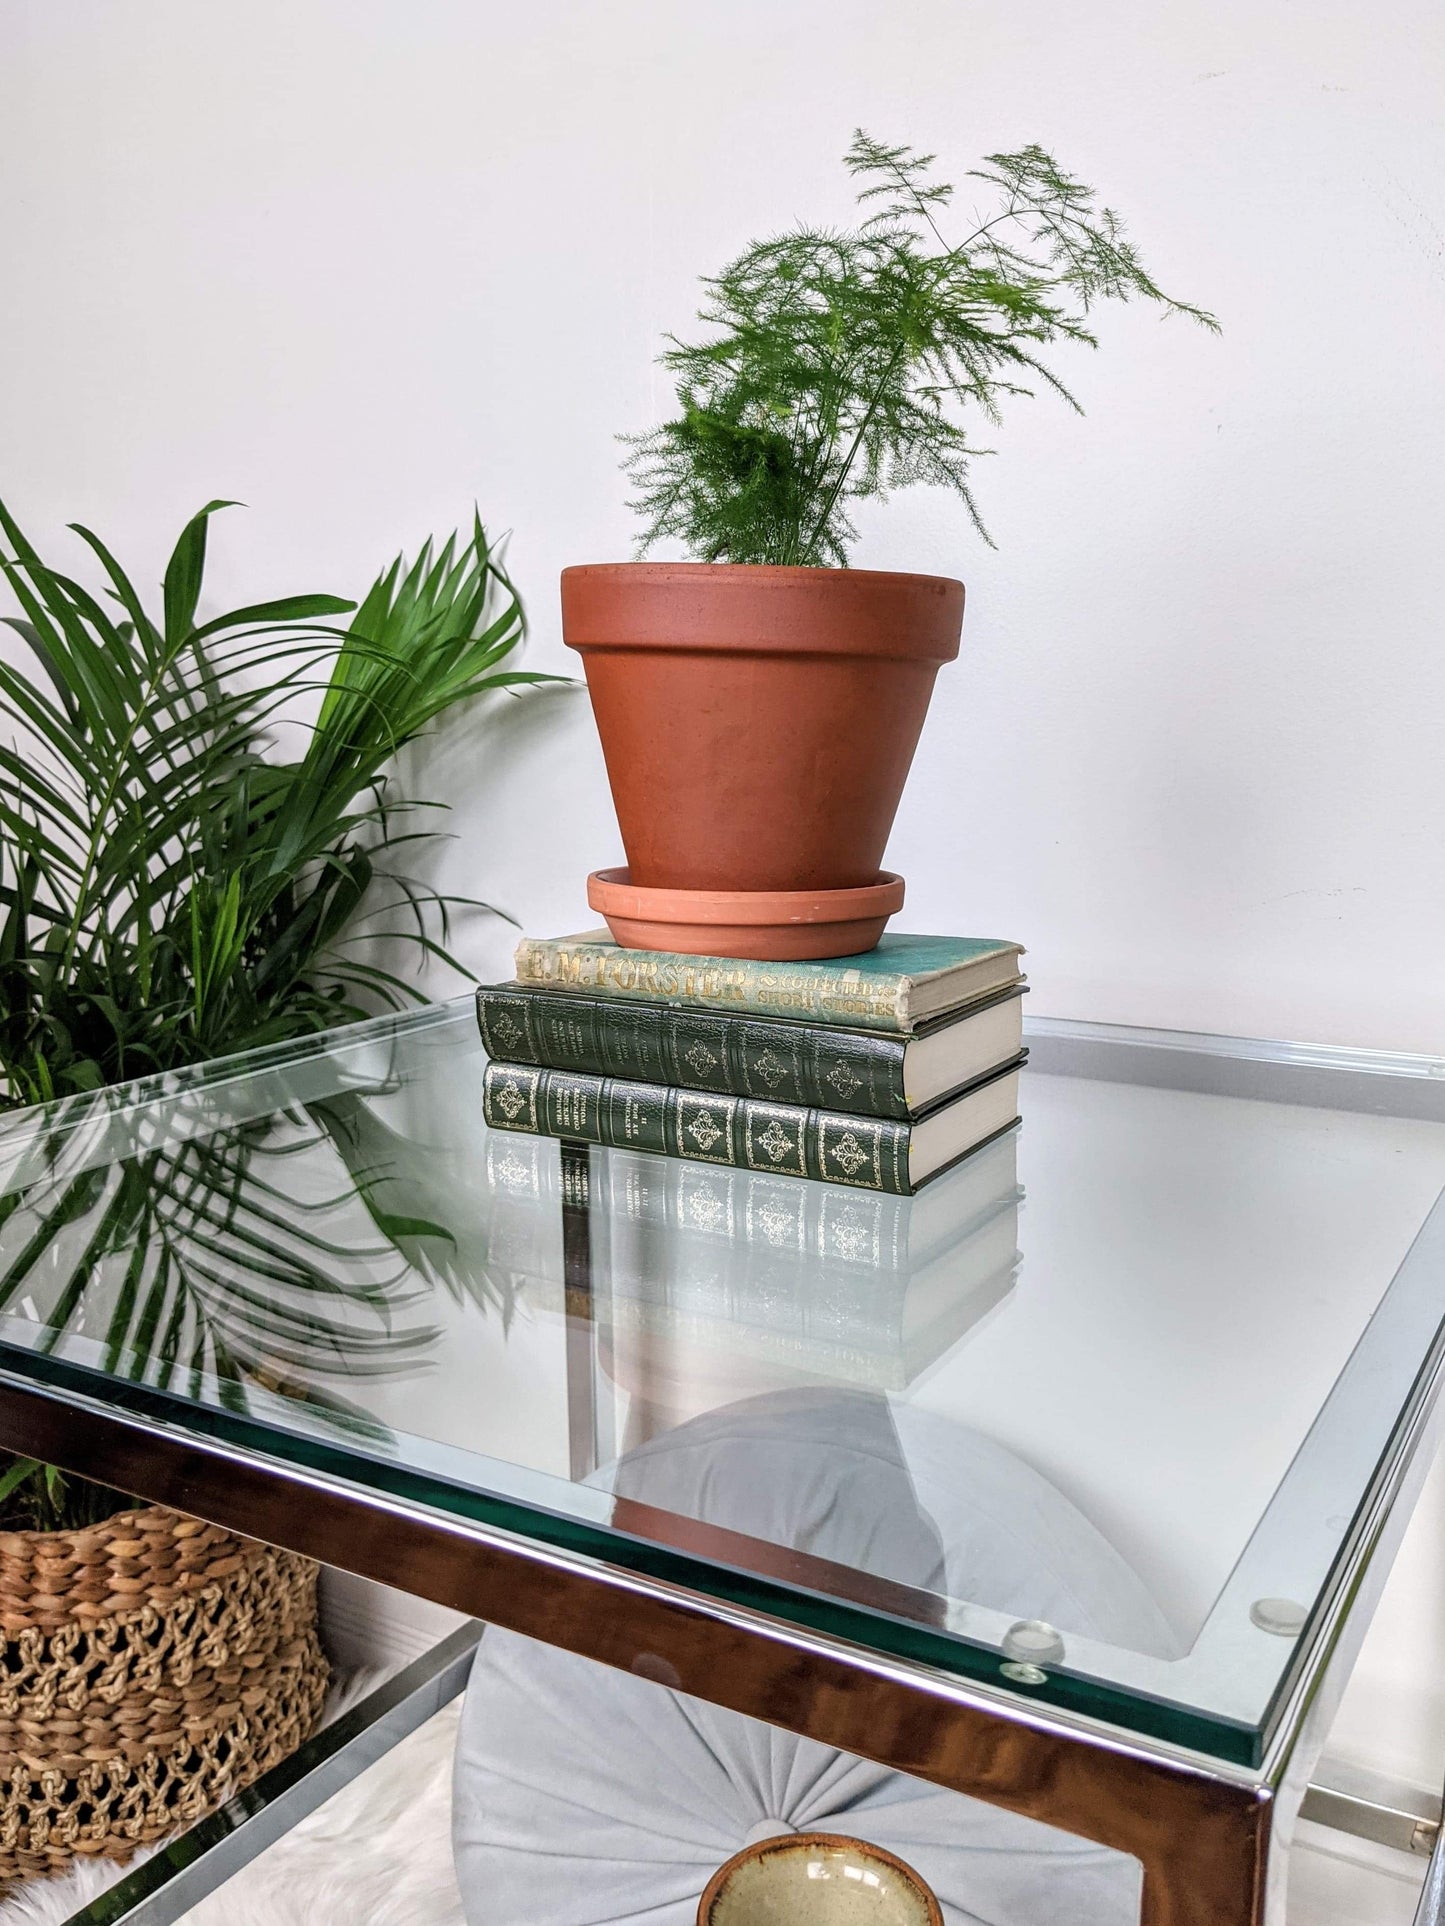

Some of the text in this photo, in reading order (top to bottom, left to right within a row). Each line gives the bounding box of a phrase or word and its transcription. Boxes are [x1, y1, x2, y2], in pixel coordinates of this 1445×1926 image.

[597, 956, 746, 1000] FORSTER
[781, 976, 873, 996] COLLECTED
[757, 990, 895, 1016] SHORT STORIES
[556, 1088, 564, 1126] CHARLES
[573, 1088, 581, 1131] COMPLETE
[641, 1117, 647, 1125] II
[633, 1123, 639, 1135] BY
[893, 1156, 902, 1193] CENTENNIAL
